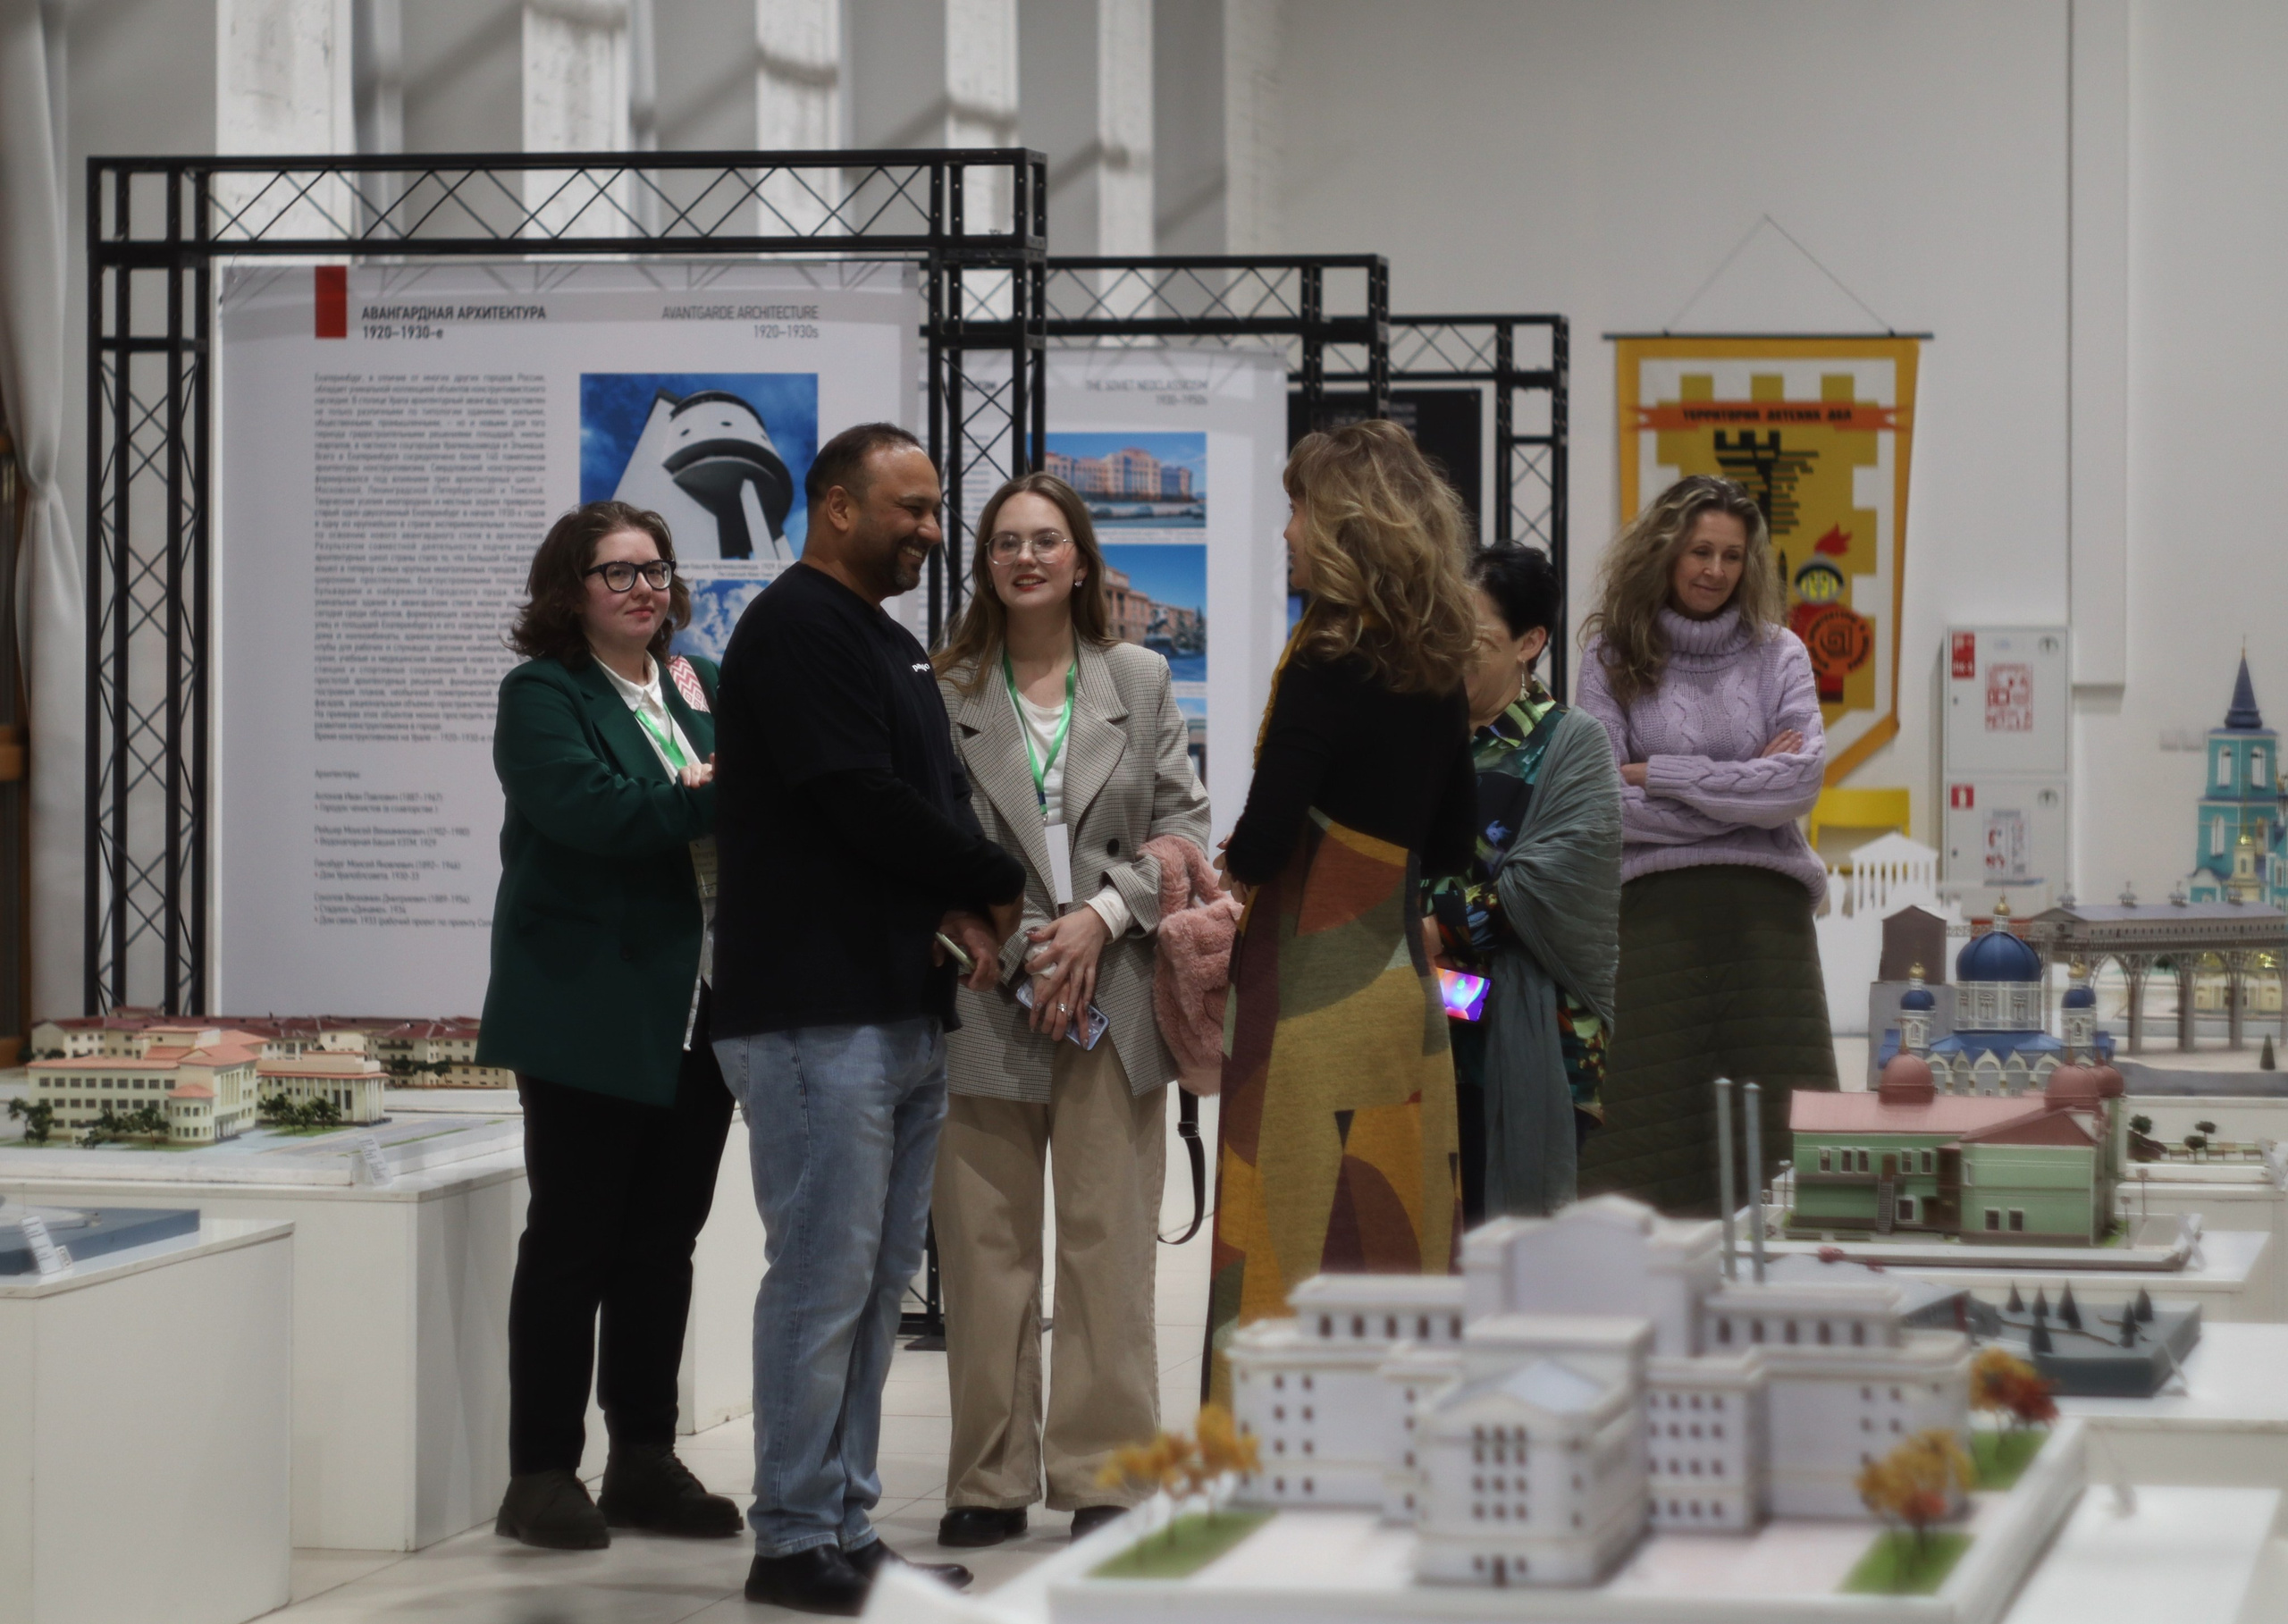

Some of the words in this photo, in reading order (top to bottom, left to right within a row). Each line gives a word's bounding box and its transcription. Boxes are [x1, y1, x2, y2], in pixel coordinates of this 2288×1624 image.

[362, 306, 454, 322] АВАНГАРДНАЯ
[457, 306, 546, 320] АРХИТЕКТУРА
[661, 306, 735, 320] AVANTGARDE
[736, 306, 820, 320] ARCHITECTURE
